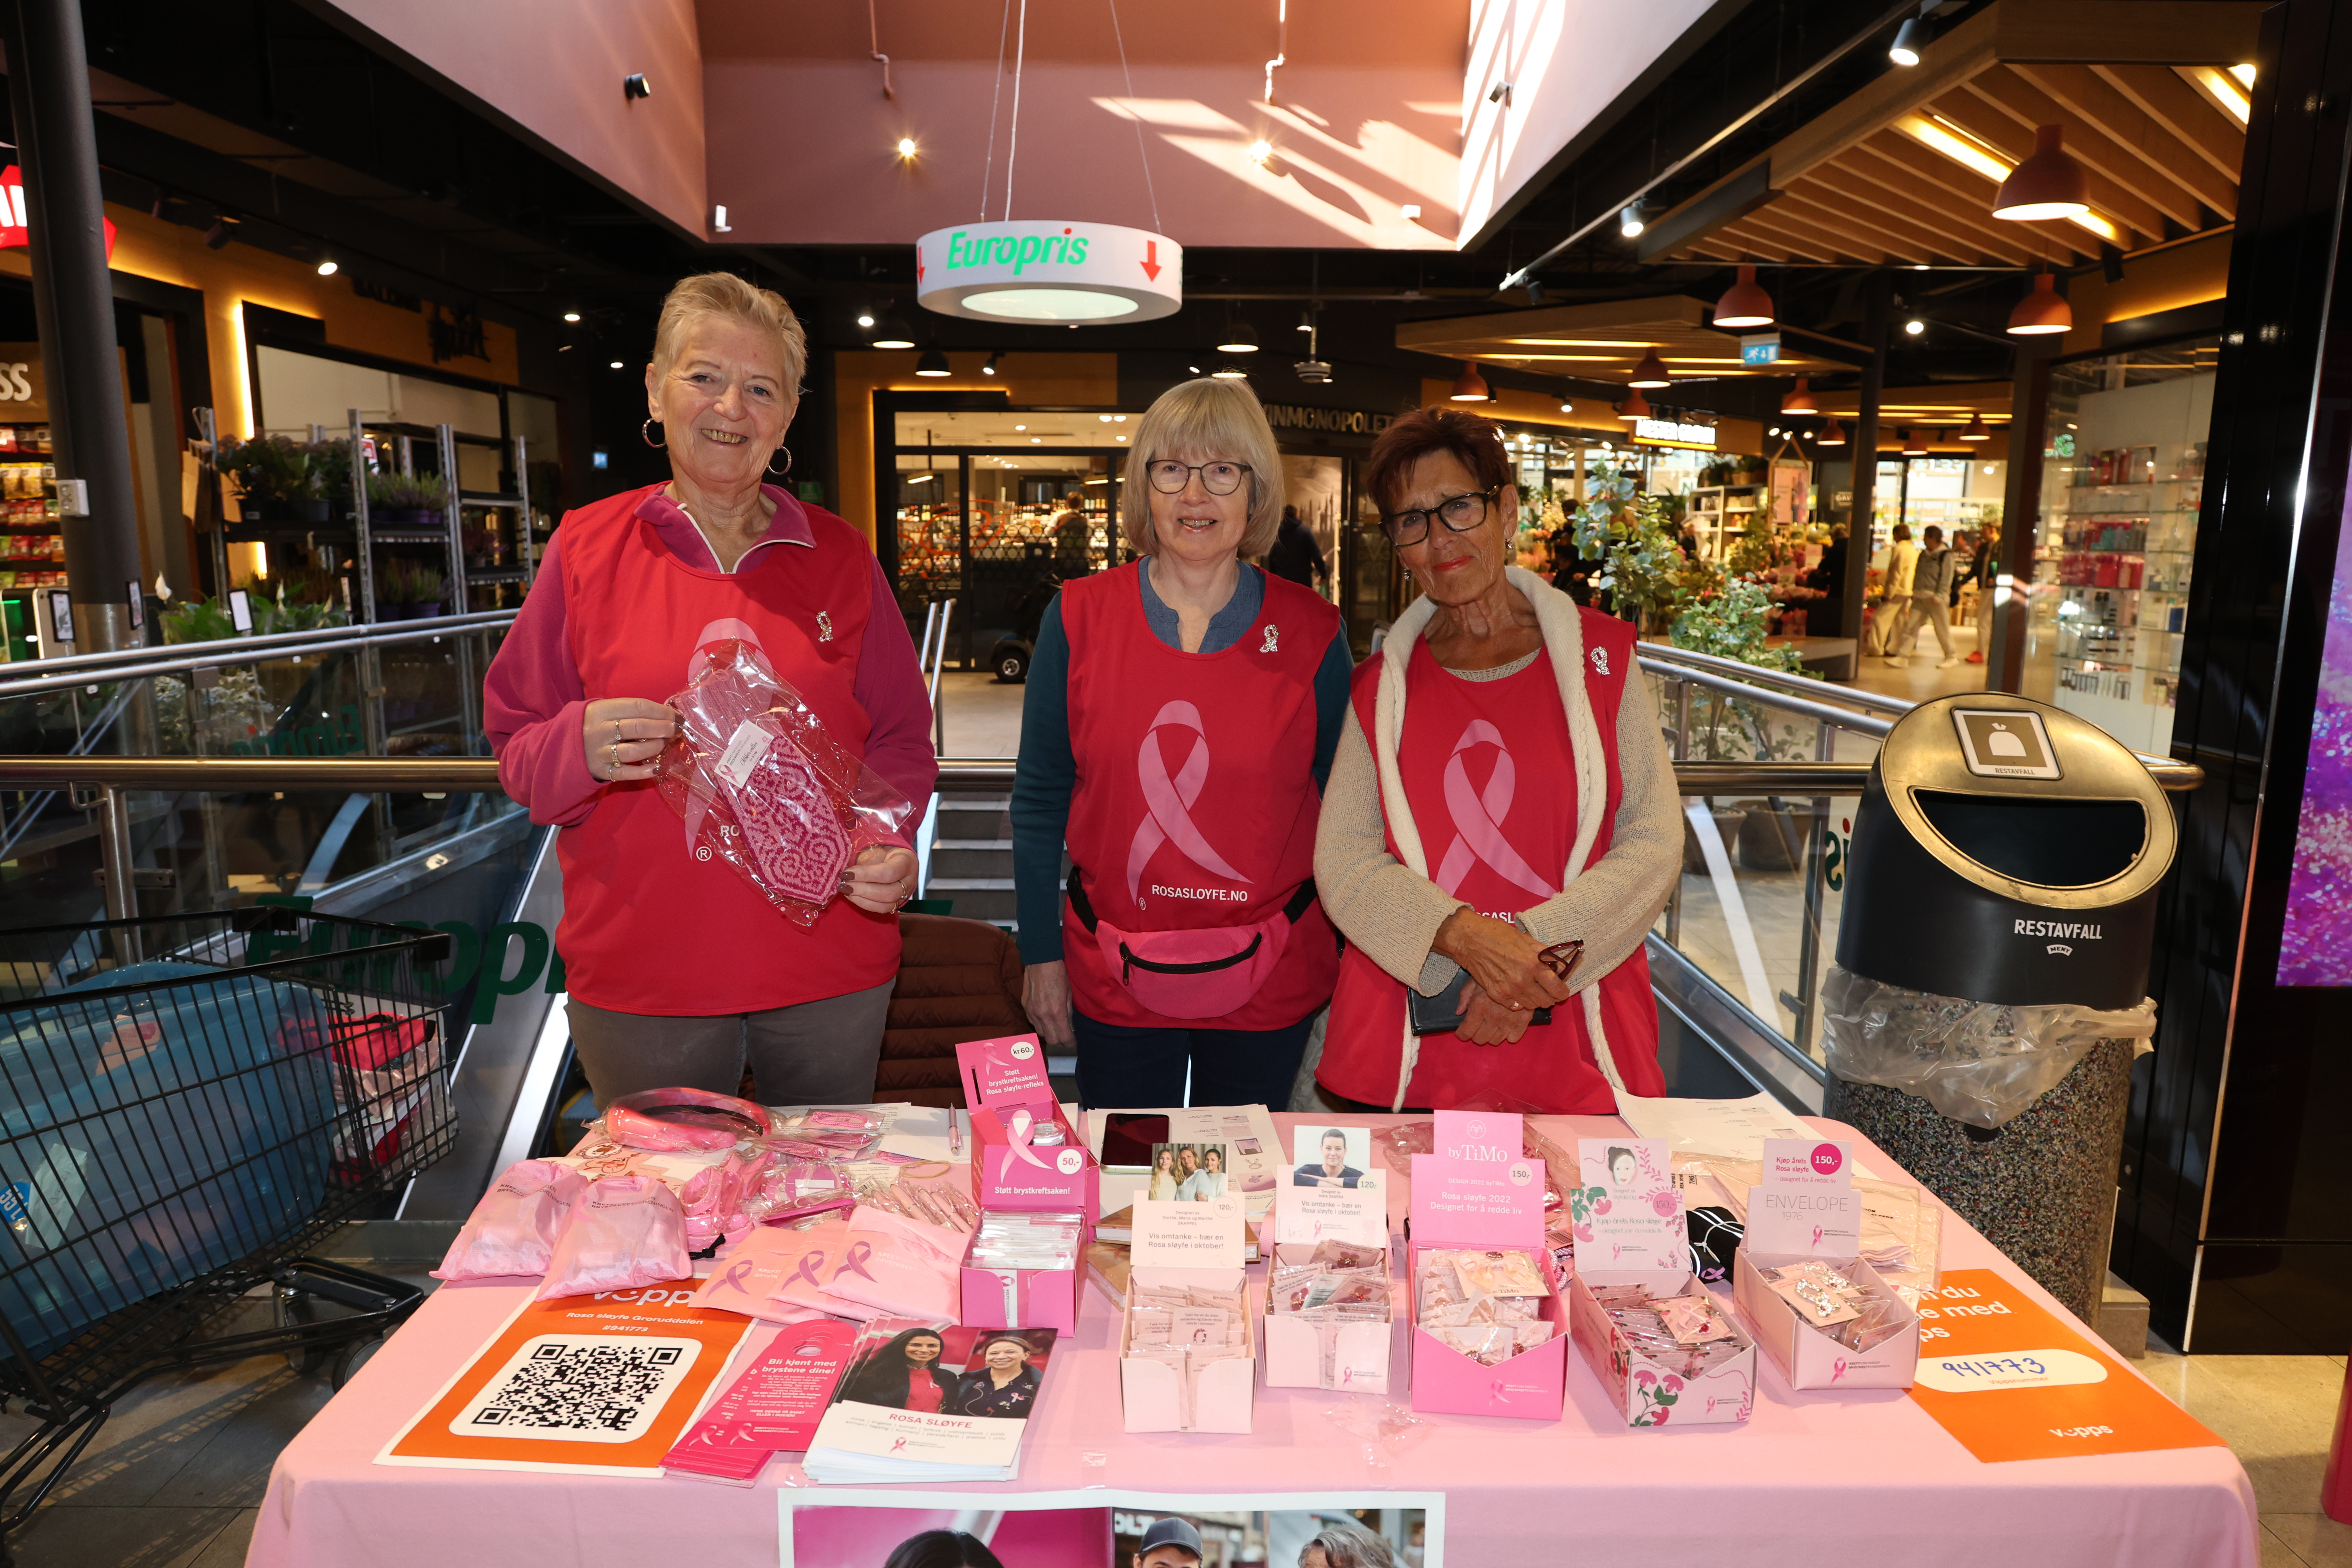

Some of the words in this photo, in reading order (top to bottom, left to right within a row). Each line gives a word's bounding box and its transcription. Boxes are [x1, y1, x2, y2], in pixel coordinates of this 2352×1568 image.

[947, 228, 1089, 275] Europris
[1995, 767, 2035, 775] RESTAVFALL
[1152, 884, 1248, 902] ROSASLOYFE.NO
[2014, 919, 2103, 940] RESTAVFALL
[2049, 946, 2071, 954] MENY
[988, 1073, 1038, 1087] brystkreftsaken!
[1003, 1081, 1044, 1093] sløyfe-refleks
[1448, 1144, 1508, 1162] byTiMo
[1062, 1158, 1080, 1167] 50,-
[1815, 1156, 1838, 1166] 150,-
[1512, 1170, 1530, 1179] 150,-
[1361, 1181, 1377, 1189] 120,-
[1014, 1187, 1071, 1196] brystkreftsaken!
[1442, 1192, 1461, 1200] Rosa
[1463, 1193, 1486, 1203] sløyfe
[1489, 1194, 1512, 1203] 2022
[1766, 1194, 1848, 1211] ENVELOPE
[1430, 1202, 1465, 1212] Designet
[1480, 1204, 1485, 1212] å
[1488, 1206, 1511, 1214] redde
[1513, 1207, 1523, 1215] liv
[1656, 1200, 1675, 1209] 150,-
[1782, 1212, 1803, 1221] 1976
[1941, 1286, 1982, 1298] du
[1942, 1301, 2013, 1317] med
[632, 1316, 704, 1325] Groruddalen
[785, 1359, 811, 1367] kjent
[1942, 1357, 2045, 1377] 941773
[762, 1366, 807, 1374] brystene
[1988, 1376, 2050, 1385] Vippsnummer
[889, 1414, 922, 1424] ROSA
[926, 1418, 973, 1429] SLØYFE
